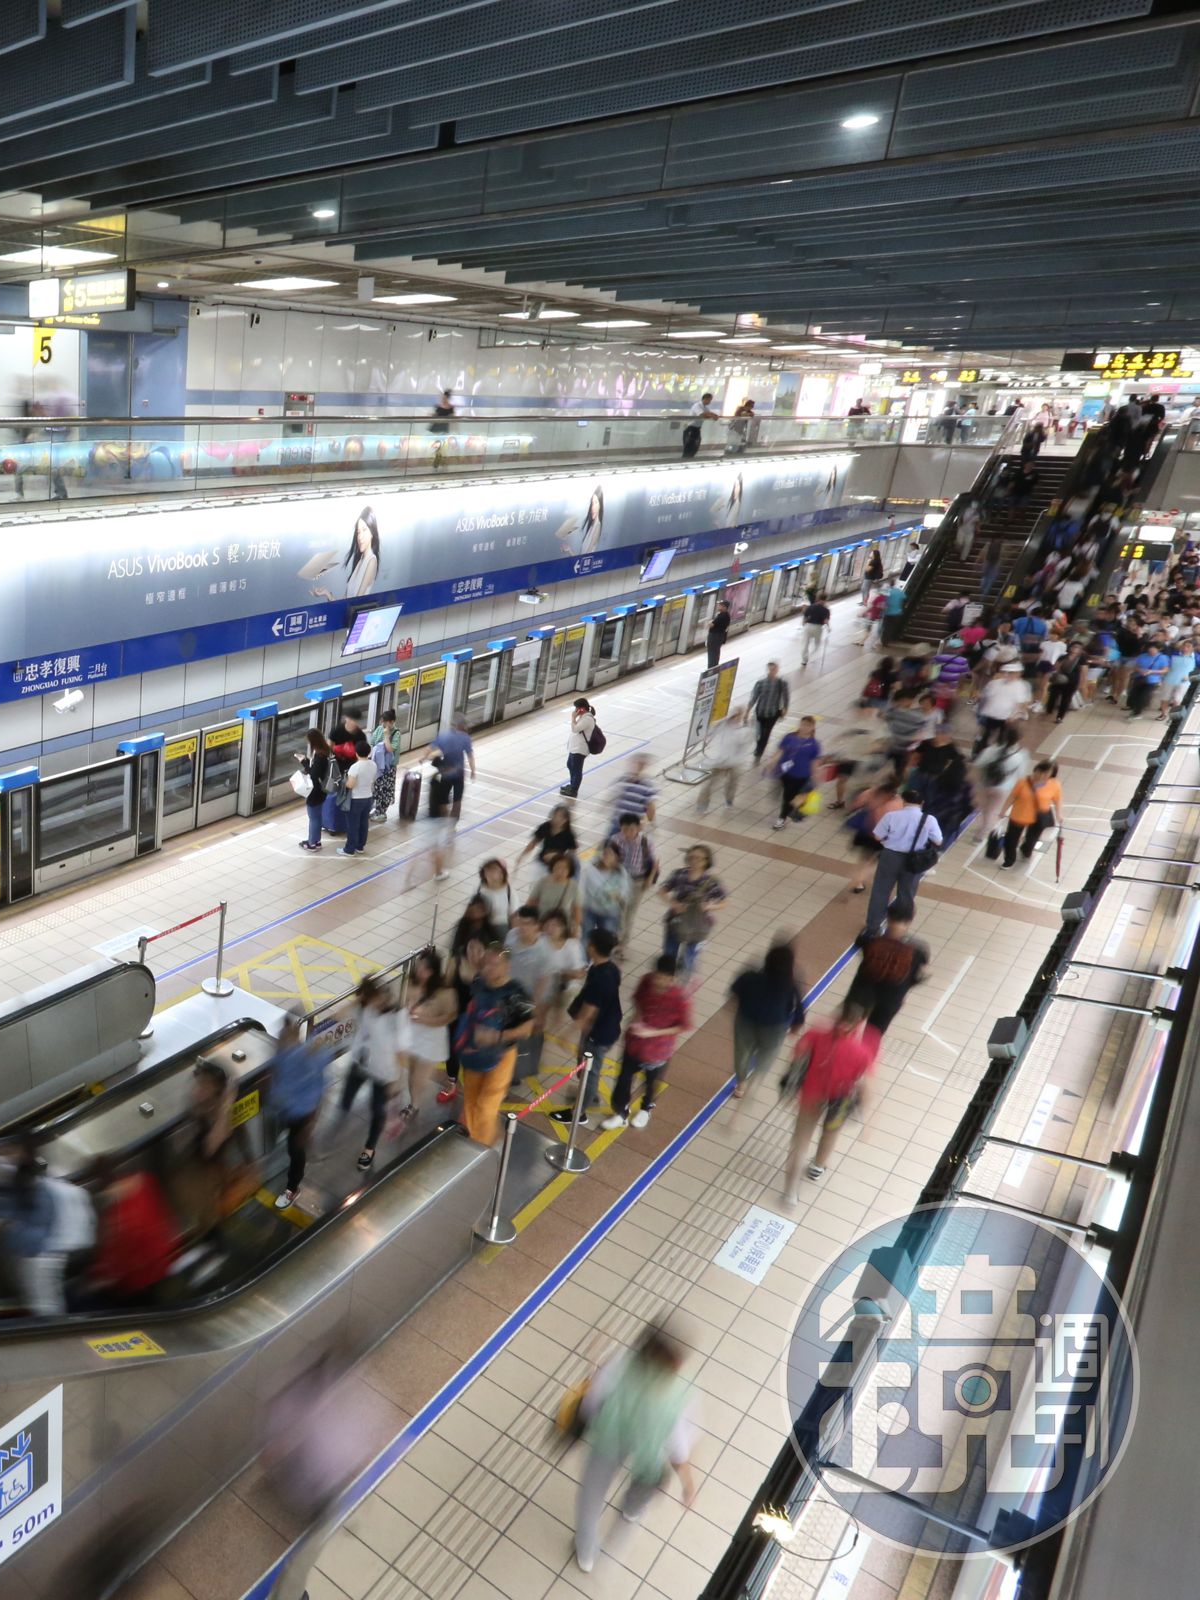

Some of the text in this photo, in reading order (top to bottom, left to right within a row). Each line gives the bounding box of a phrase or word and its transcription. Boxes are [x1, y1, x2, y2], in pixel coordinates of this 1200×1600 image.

[39, 335, 53, 364] 5
[455, 518, 475, 532] ASUS
[476, 513, 508, 529] VivoBook
[509, 513, 515, 527] S
[107, 556, 143, 579] ASUS
[147, 550, 208, 574] VivoBook
[212, 547, 220, 565] S
[24, 655, 108, 682] 忠孝復興 二月台
[21, 680, 59, 694] ZHONGXIAO
[61, 675, 83, 686] FUXING
[12, 1503, 55, 1546] 50m
